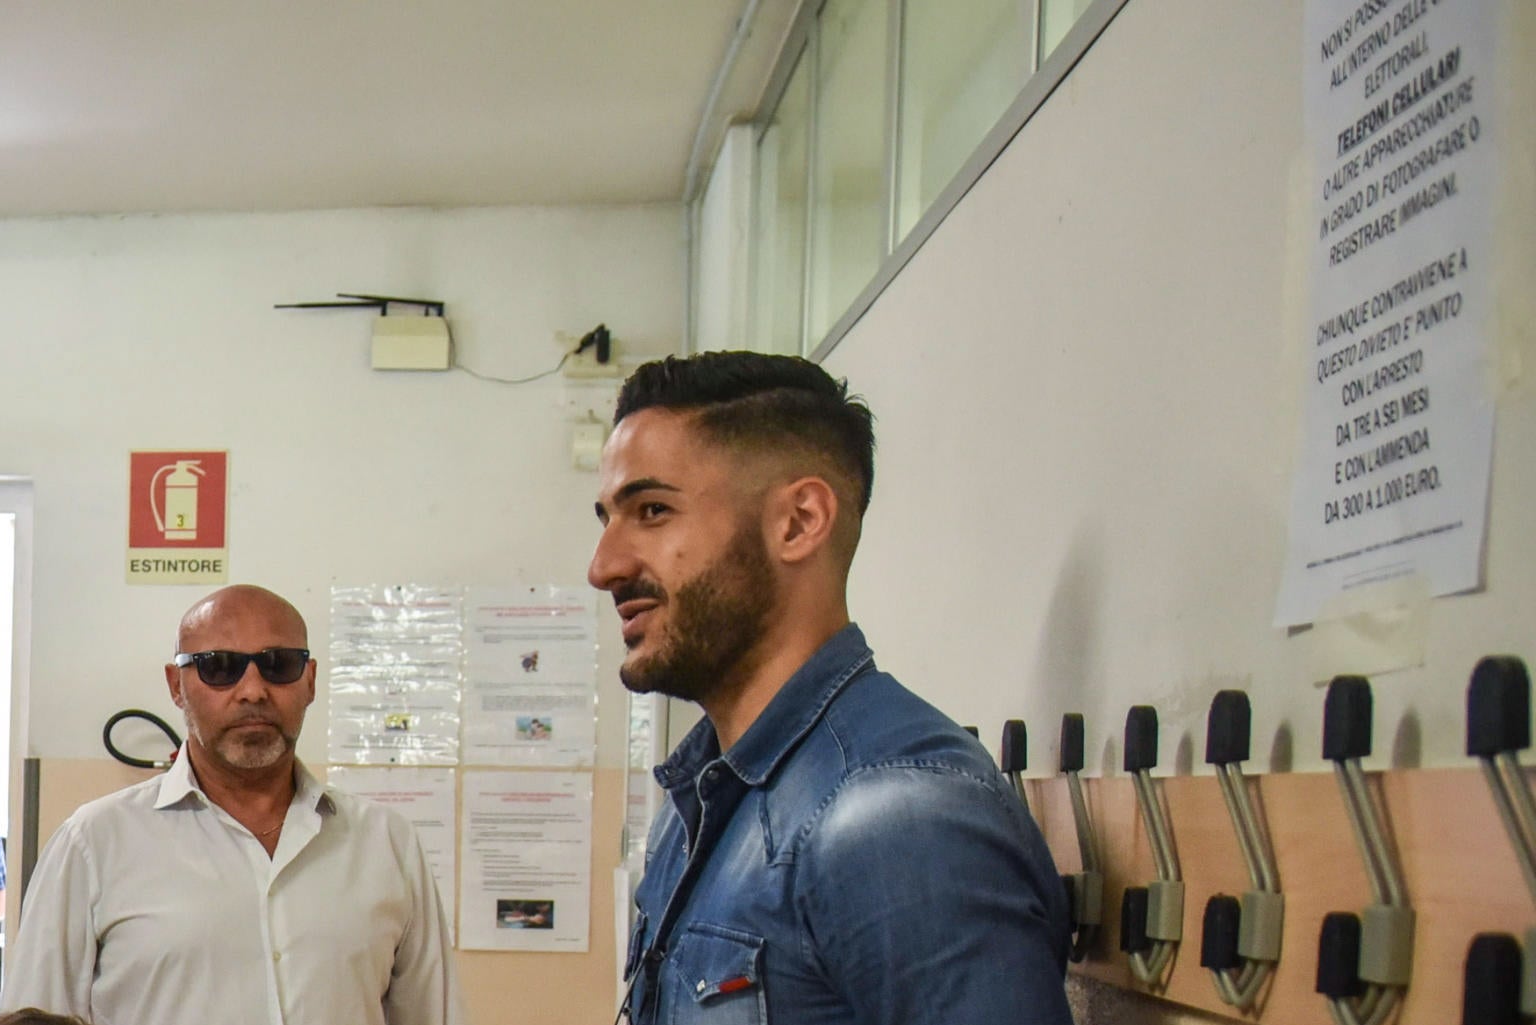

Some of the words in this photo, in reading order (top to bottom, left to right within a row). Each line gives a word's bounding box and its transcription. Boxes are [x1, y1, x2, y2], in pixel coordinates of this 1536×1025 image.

[1320, 26, 1343, 63] NON
[1344, 15, 1352, 42] SI
[1337, 98, 1390, 157] TELEFONI
[1392, 45, 1461, 117] CELLULARI
[1323, 178, 1330, 201] O
[1331, 155, 1361, 194] ALTRE
[1362, 75, 1475, 173] APPARECCHIATURE
[1320, 215, 1329, 240] IN
[1330, 190, 1363, 232] GRADO
[1366, 181, 1379, 208] DI
[1382, 123, 1466, 198] FOTOGRAFARE
[1468, 115, 1480, 142] O
[1329, 208, 1397, 267] REGISTRARE
[1317, 300, 1369, 347] CHIUNQUE
[1371, 251, 1456, 319] CONTRAVVIENE
[1459, 247, 1467, 271] A
[1317, 343, 1357, 384] QUESTO
[1359, 322, 1401, 362] DIVIETO
[1416, 291, 1462, 333] PUNITO
[1336, 421, 1351, 447] DA
[1353, 411, 1371, 440] TRE
[1374, 408, 1381, 430] A
[1383, 399, 1399, 428] SEI
[1402, 384, 1430, 418] MESI
[1342, 378, 1364, 407] CON
[1335, 461, 1342, 485] E
[1345, 454, 1366, 481] CON
[176, 513, 185, 528] 3
[1325, 500, 1340, 524] DA
[1343, 491, 1364, 519] 300
[1366, 489, 1373, 510] A
[130, 559, 223, 573] ESTINTORE
